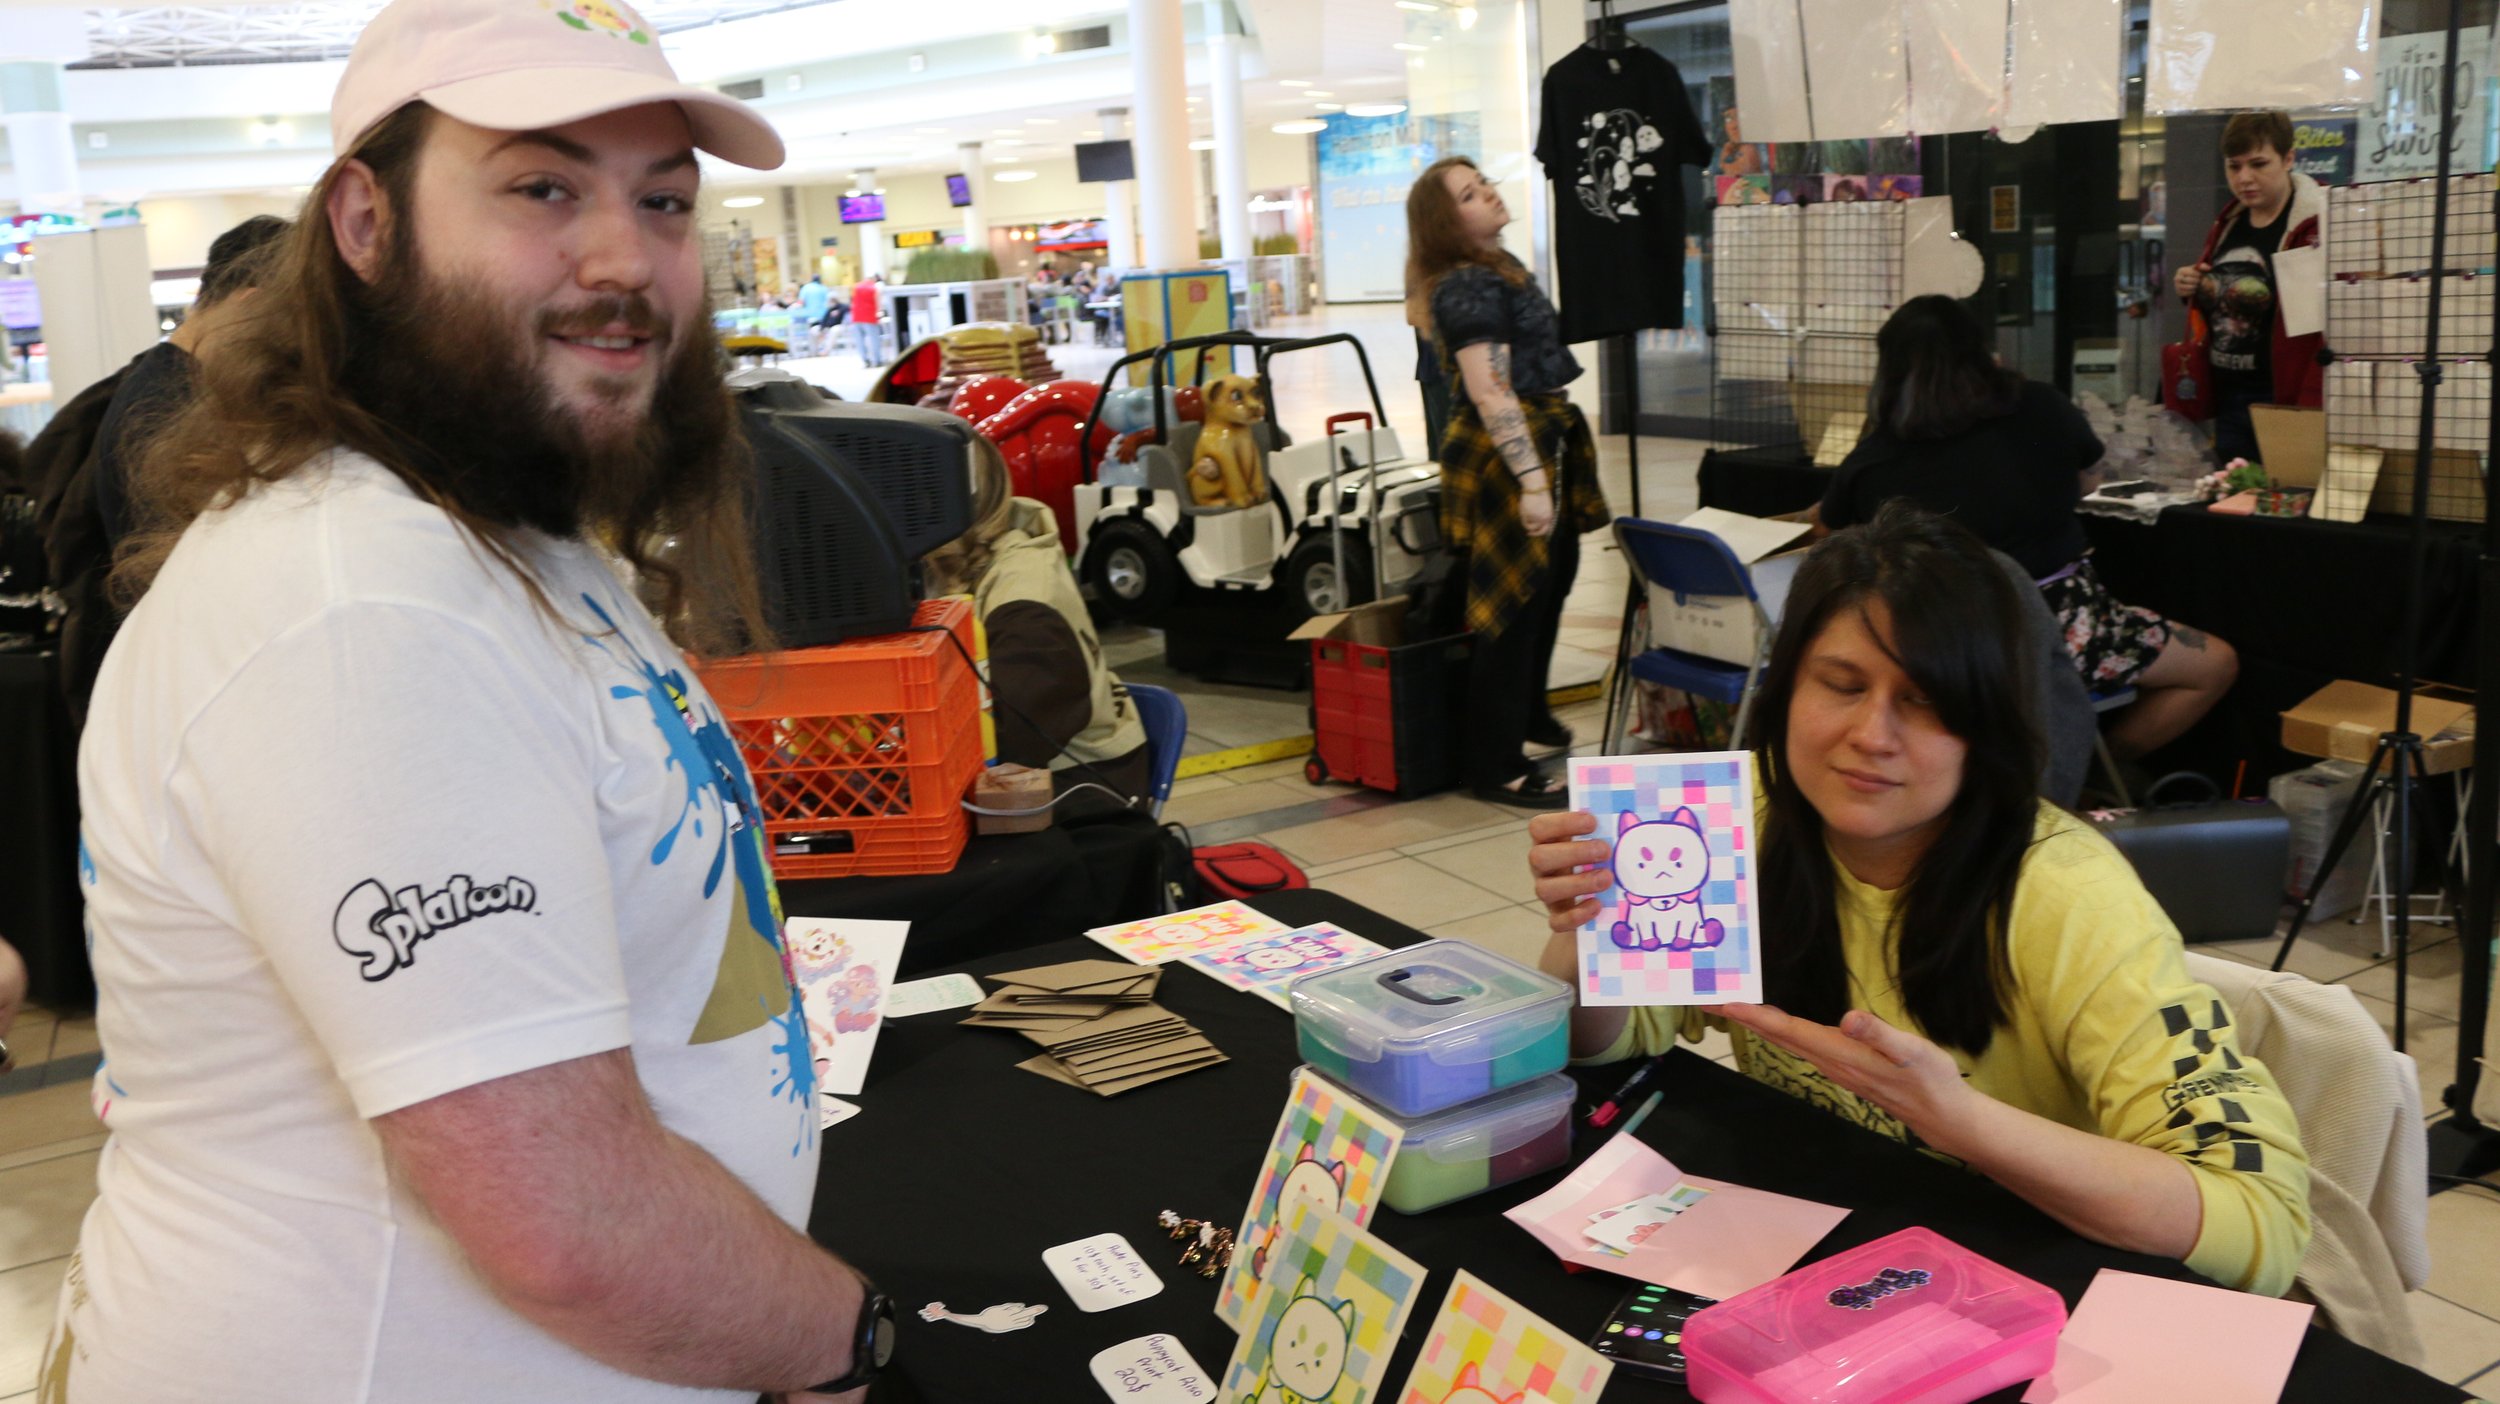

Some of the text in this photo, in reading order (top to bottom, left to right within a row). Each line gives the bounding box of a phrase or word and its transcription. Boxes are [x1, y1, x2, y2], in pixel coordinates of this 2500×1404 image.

[2369, 61, 2475, 119] HURO
[2294, 124, 2346, 149] Bites
[332, 874, 537, 983] Splatoon
[1146, 1335, 1186, 1374] Puppycat
[1113, 1367, 1152, 1394] 20$
